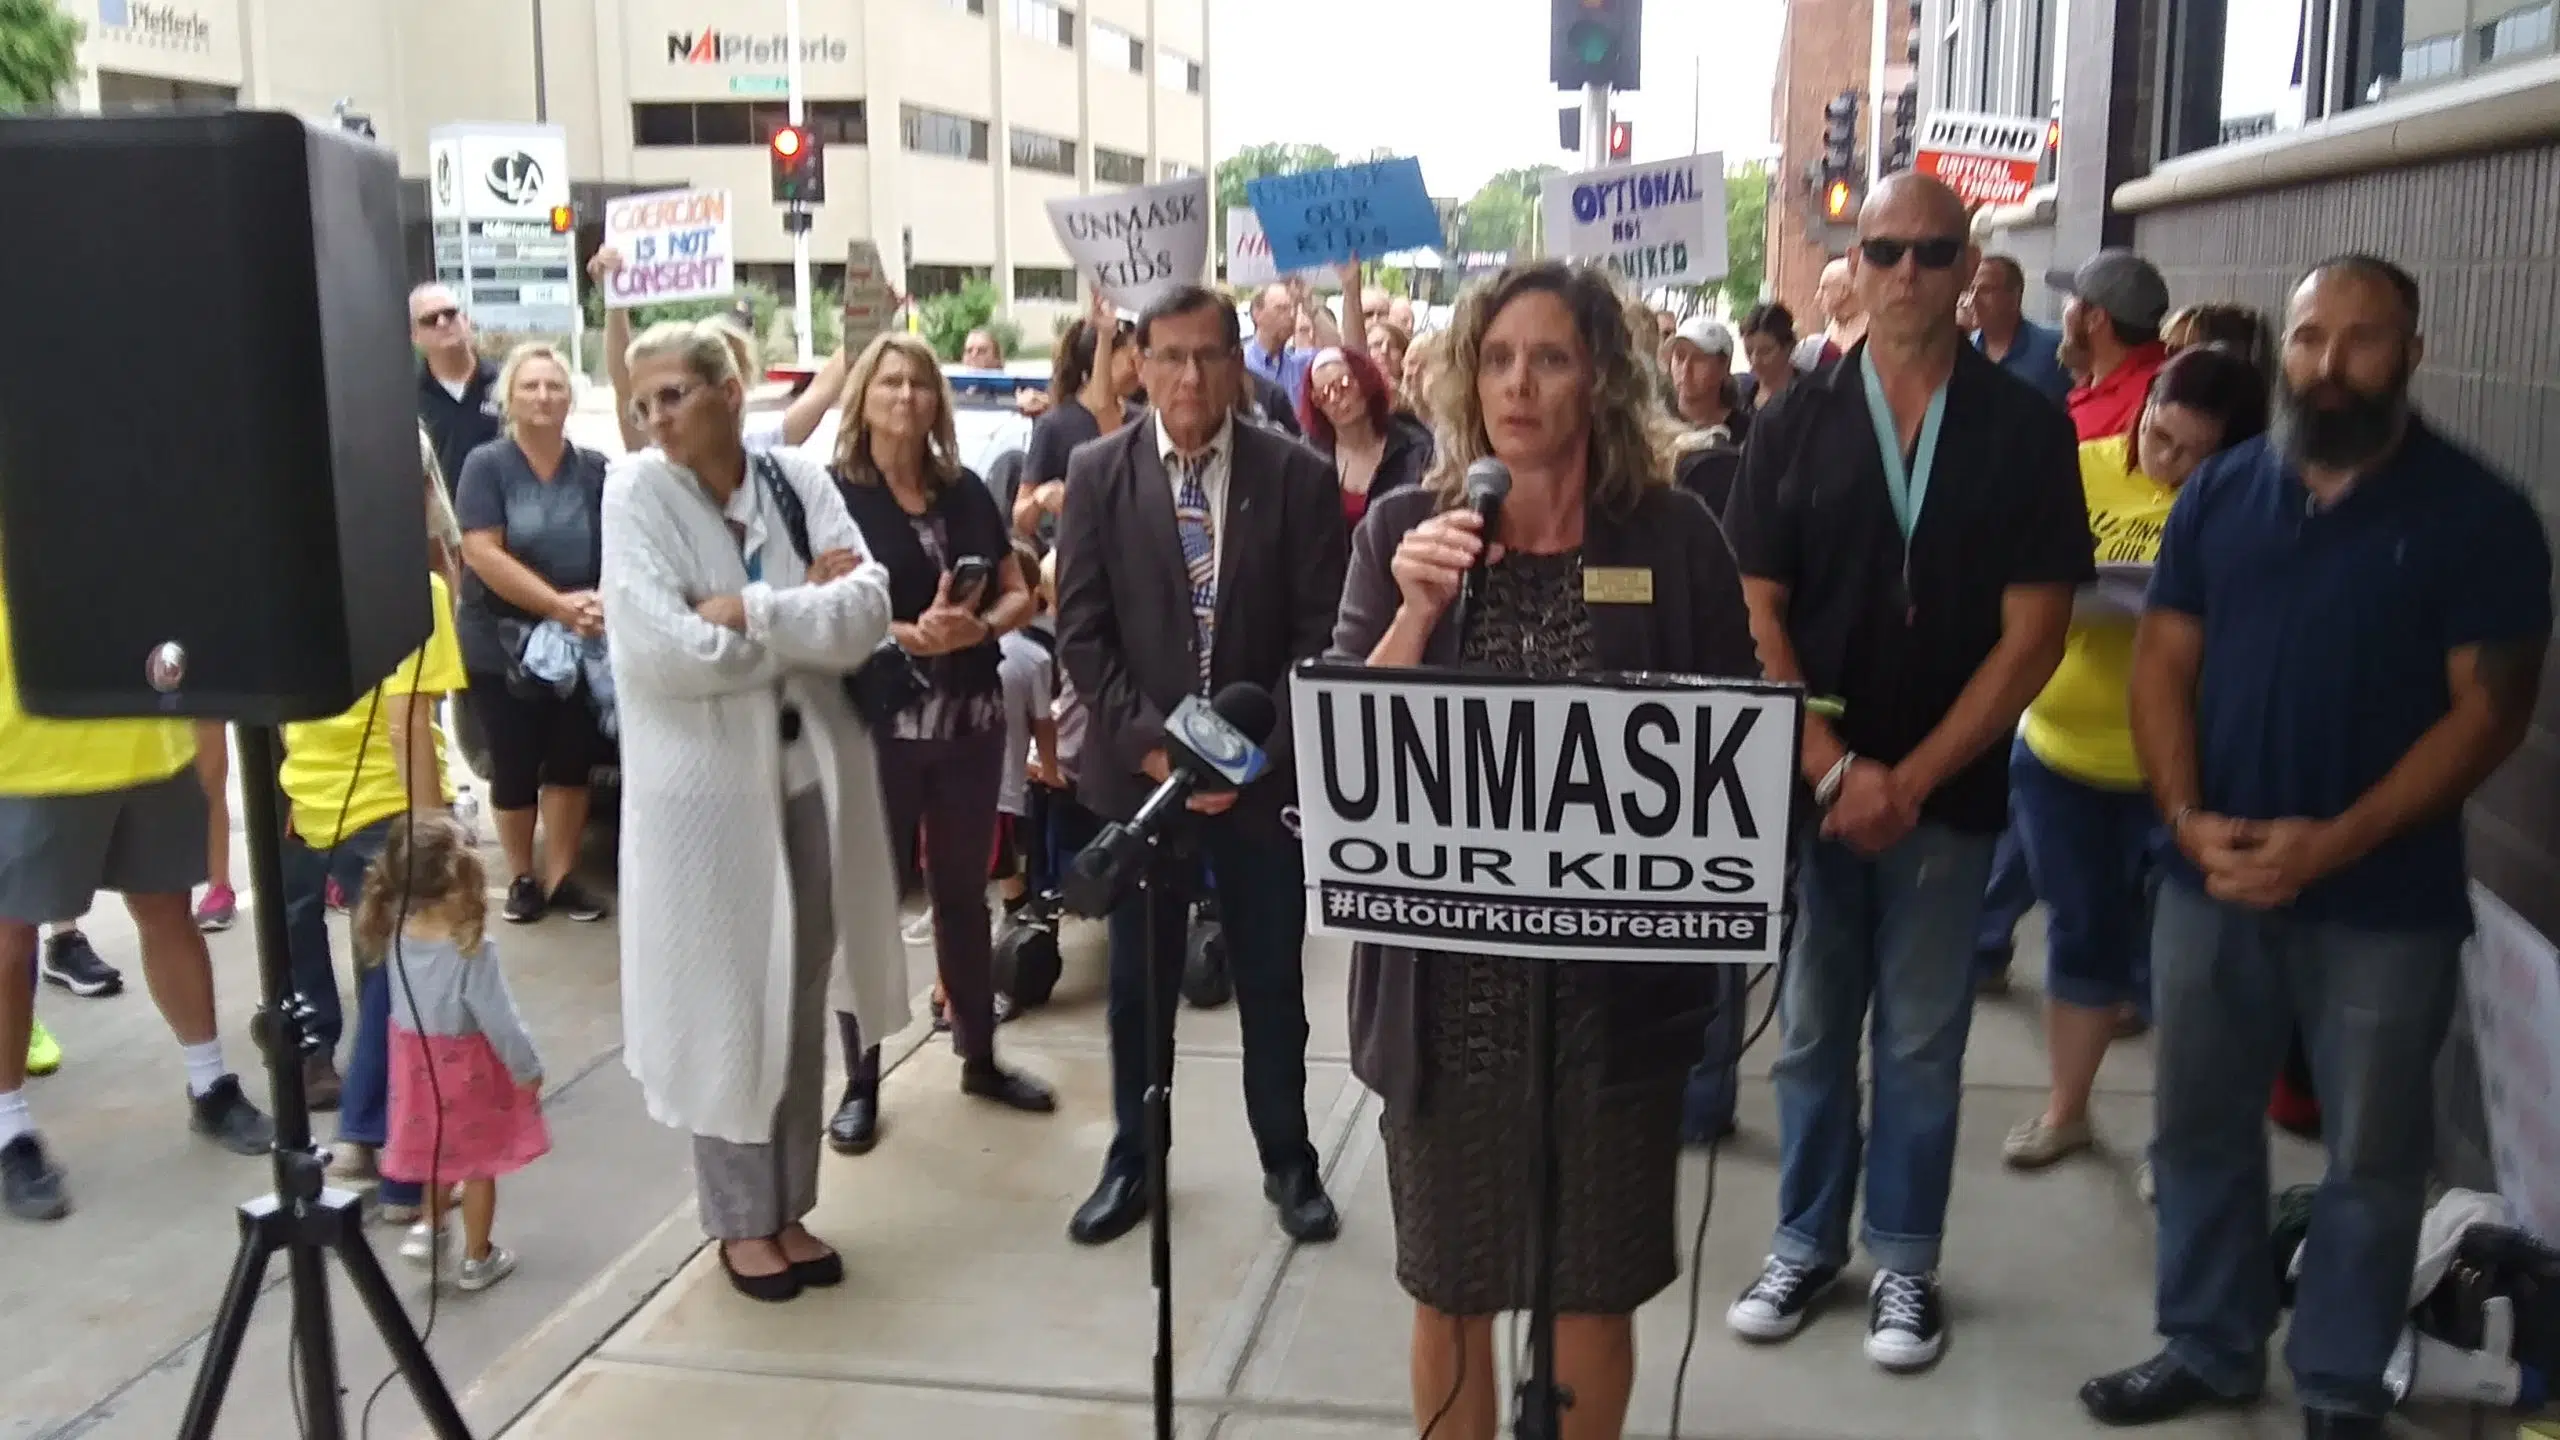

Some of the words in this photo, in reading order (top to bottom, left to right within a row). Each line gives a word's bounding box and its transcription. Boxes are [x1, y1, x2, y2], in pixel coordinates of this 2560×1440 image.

[1930, 120, 2038, 151] DEFUND
[1936, 153, 2012, 182] CRITICAL
[611, 189, 724, 233] COERCION
[1304, 197, 1371, 228] OUR
[1571, 167, 1704, 224] OPTIONAL
[1066, 193, 1198, 241] UNMASK
[1612, 214, 1641, 245] NOT
[634, 235, 656, 262] IS
[667, 226, 716, 260] NOT
[1296, 224, 1389, 254] KIDS
[611, 255, 724, 298] CONSENT
[1095, 250, 1173, 287] KIDS
[1596, 240, 1688, 281] QUIRED
[1316, 690, 1763, 839] UNMASK
[1328, 837, 1517, 888] OUR
[1548, 850, 1756, 894] KIDS
[1328, 886, 1757, 941] #letourkidsbreathe
